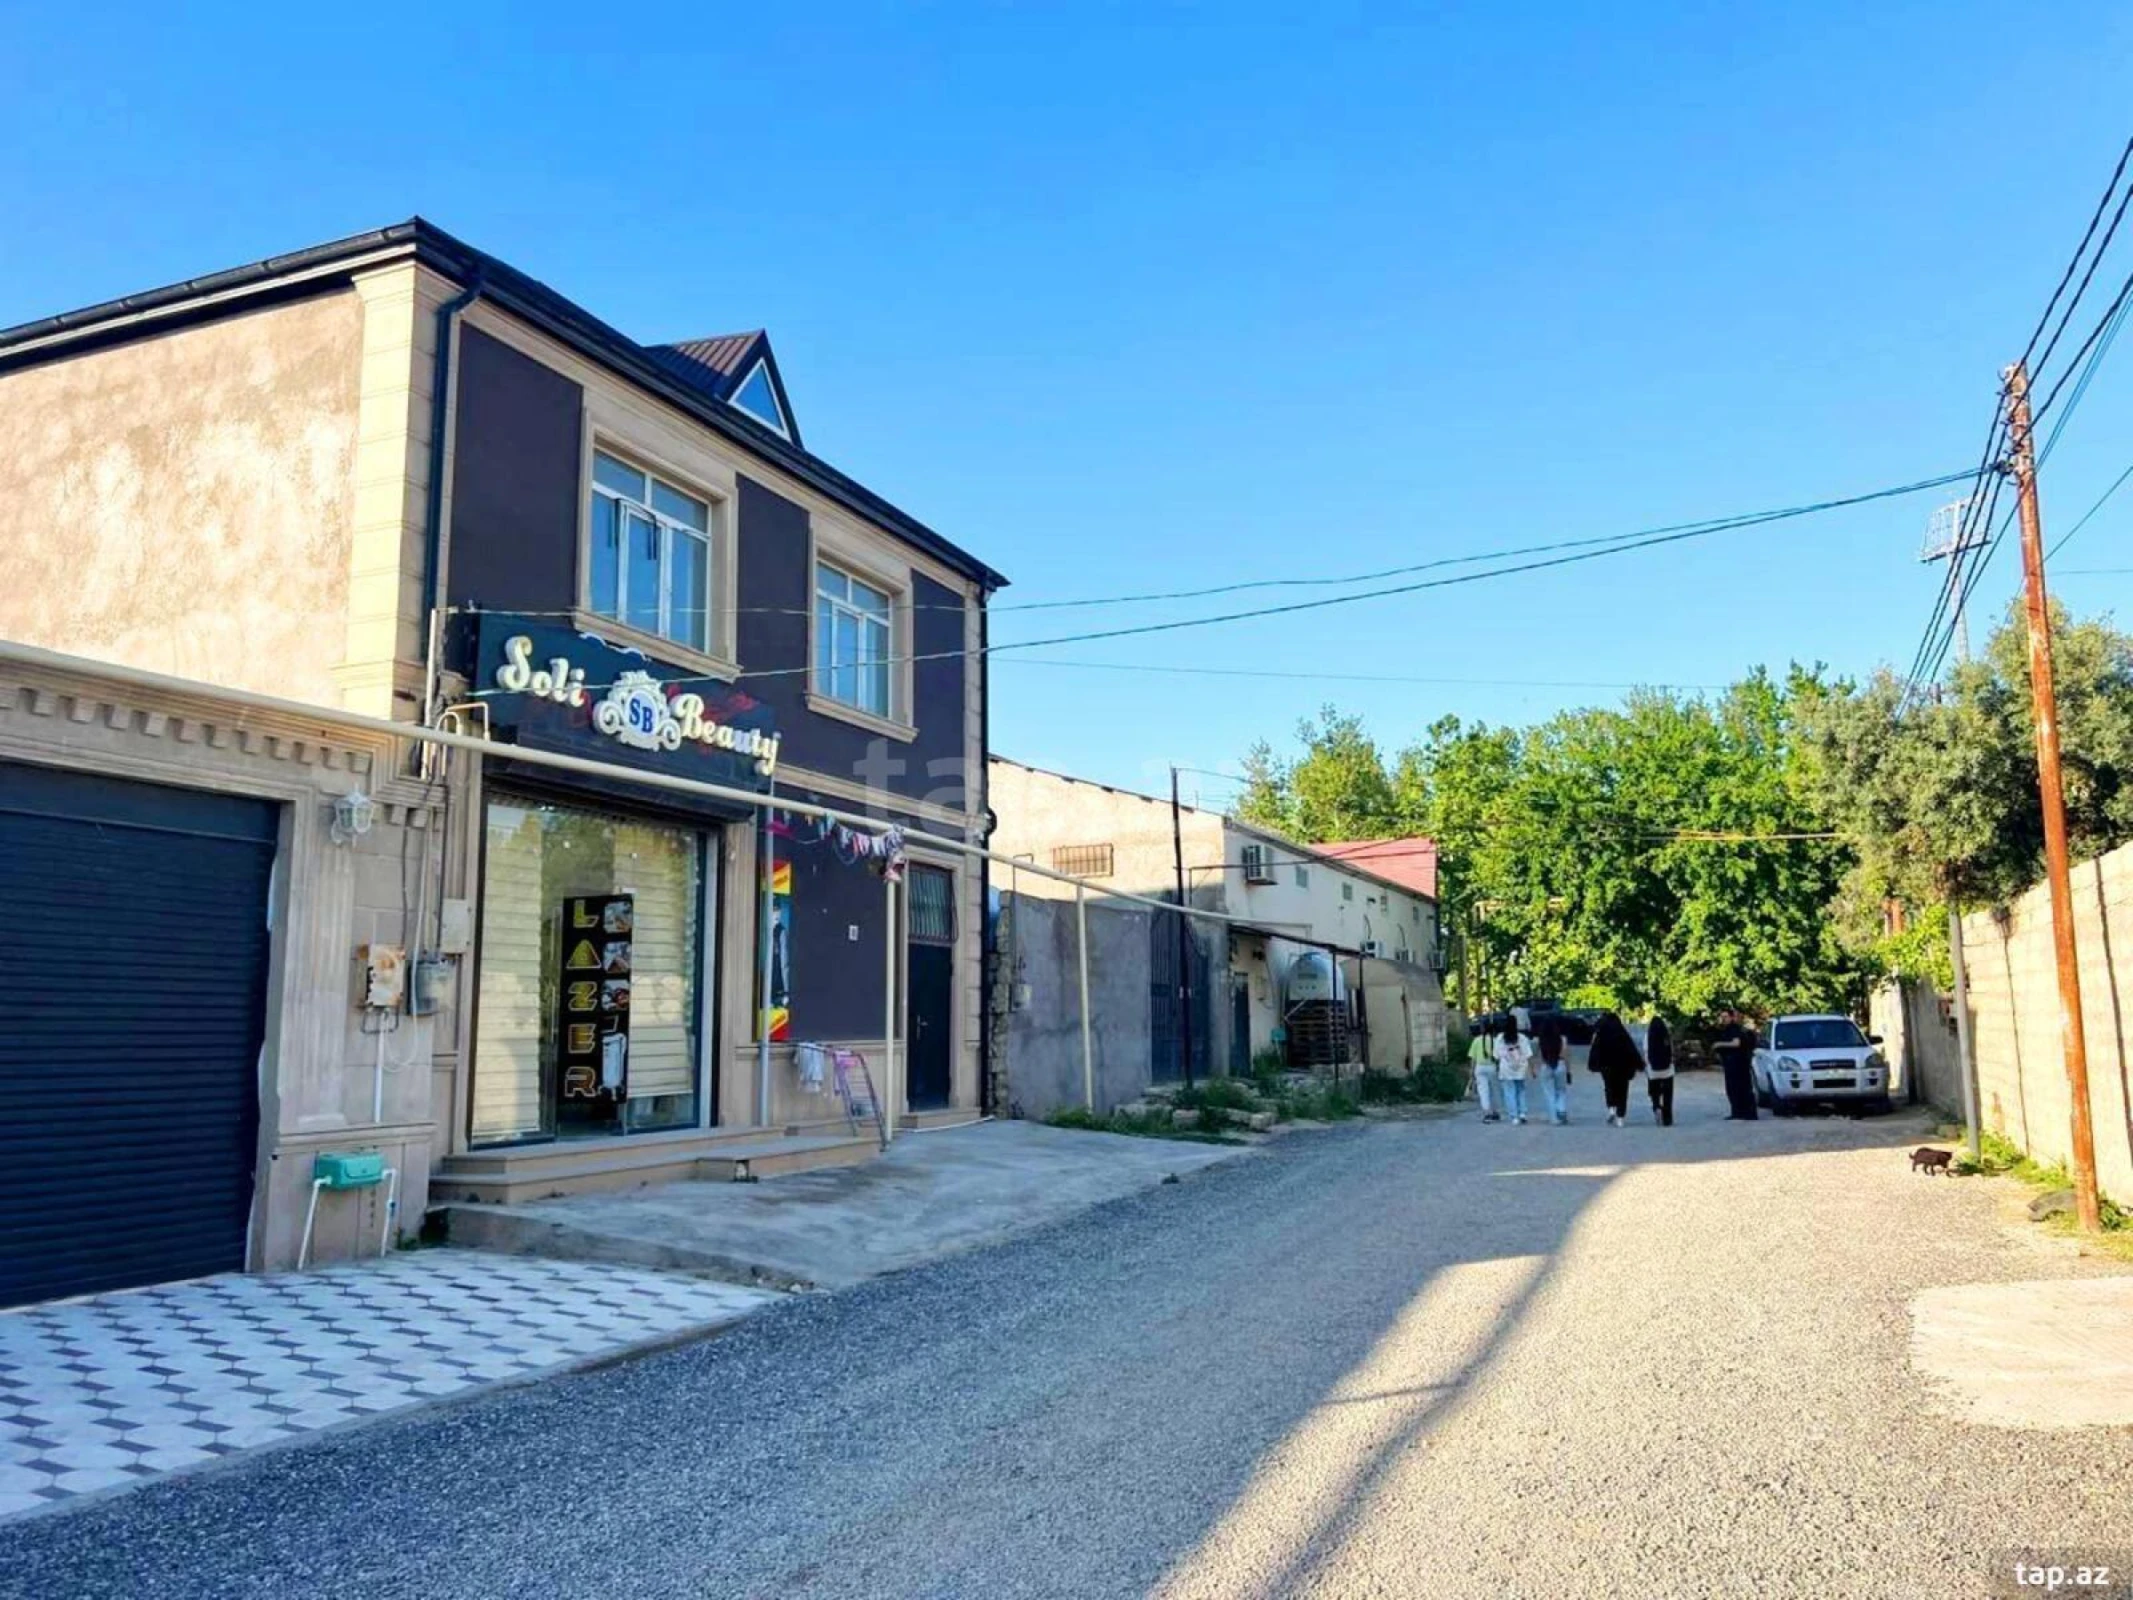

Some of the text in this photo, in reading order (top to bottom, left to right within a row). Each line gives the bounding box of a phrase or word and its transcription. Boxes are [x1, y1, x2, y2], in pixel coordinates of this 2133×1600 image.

[496, 636, 782, 776] Soli SB Beauty
[565, 898, 602, 1098] LAZER
